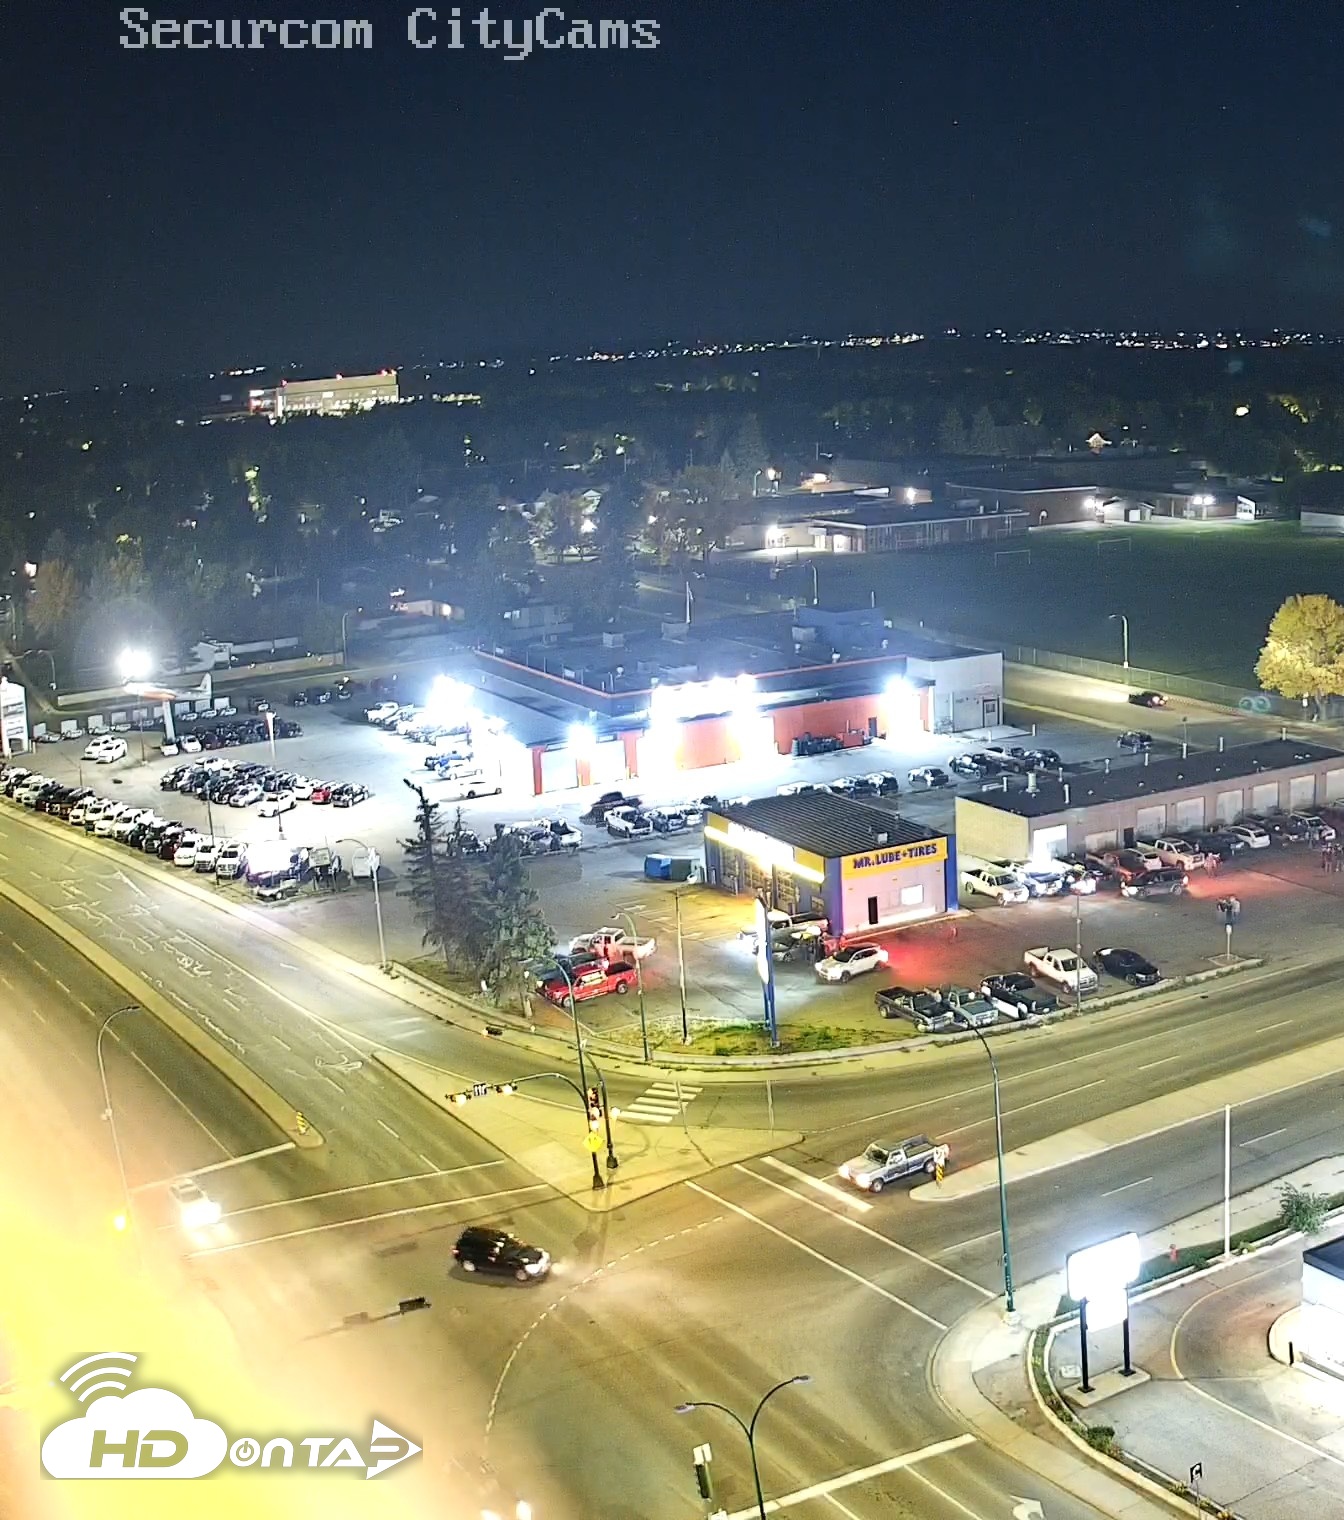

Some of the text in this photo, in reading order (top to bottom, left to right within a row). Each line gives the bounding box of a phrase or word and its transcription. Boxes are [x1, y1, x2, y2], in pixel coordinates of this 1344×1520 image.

[853, 855, 875, 869] MR.
[875, 850, 901, 865] LUBE
[907, 843, 937, 859] TIRES
